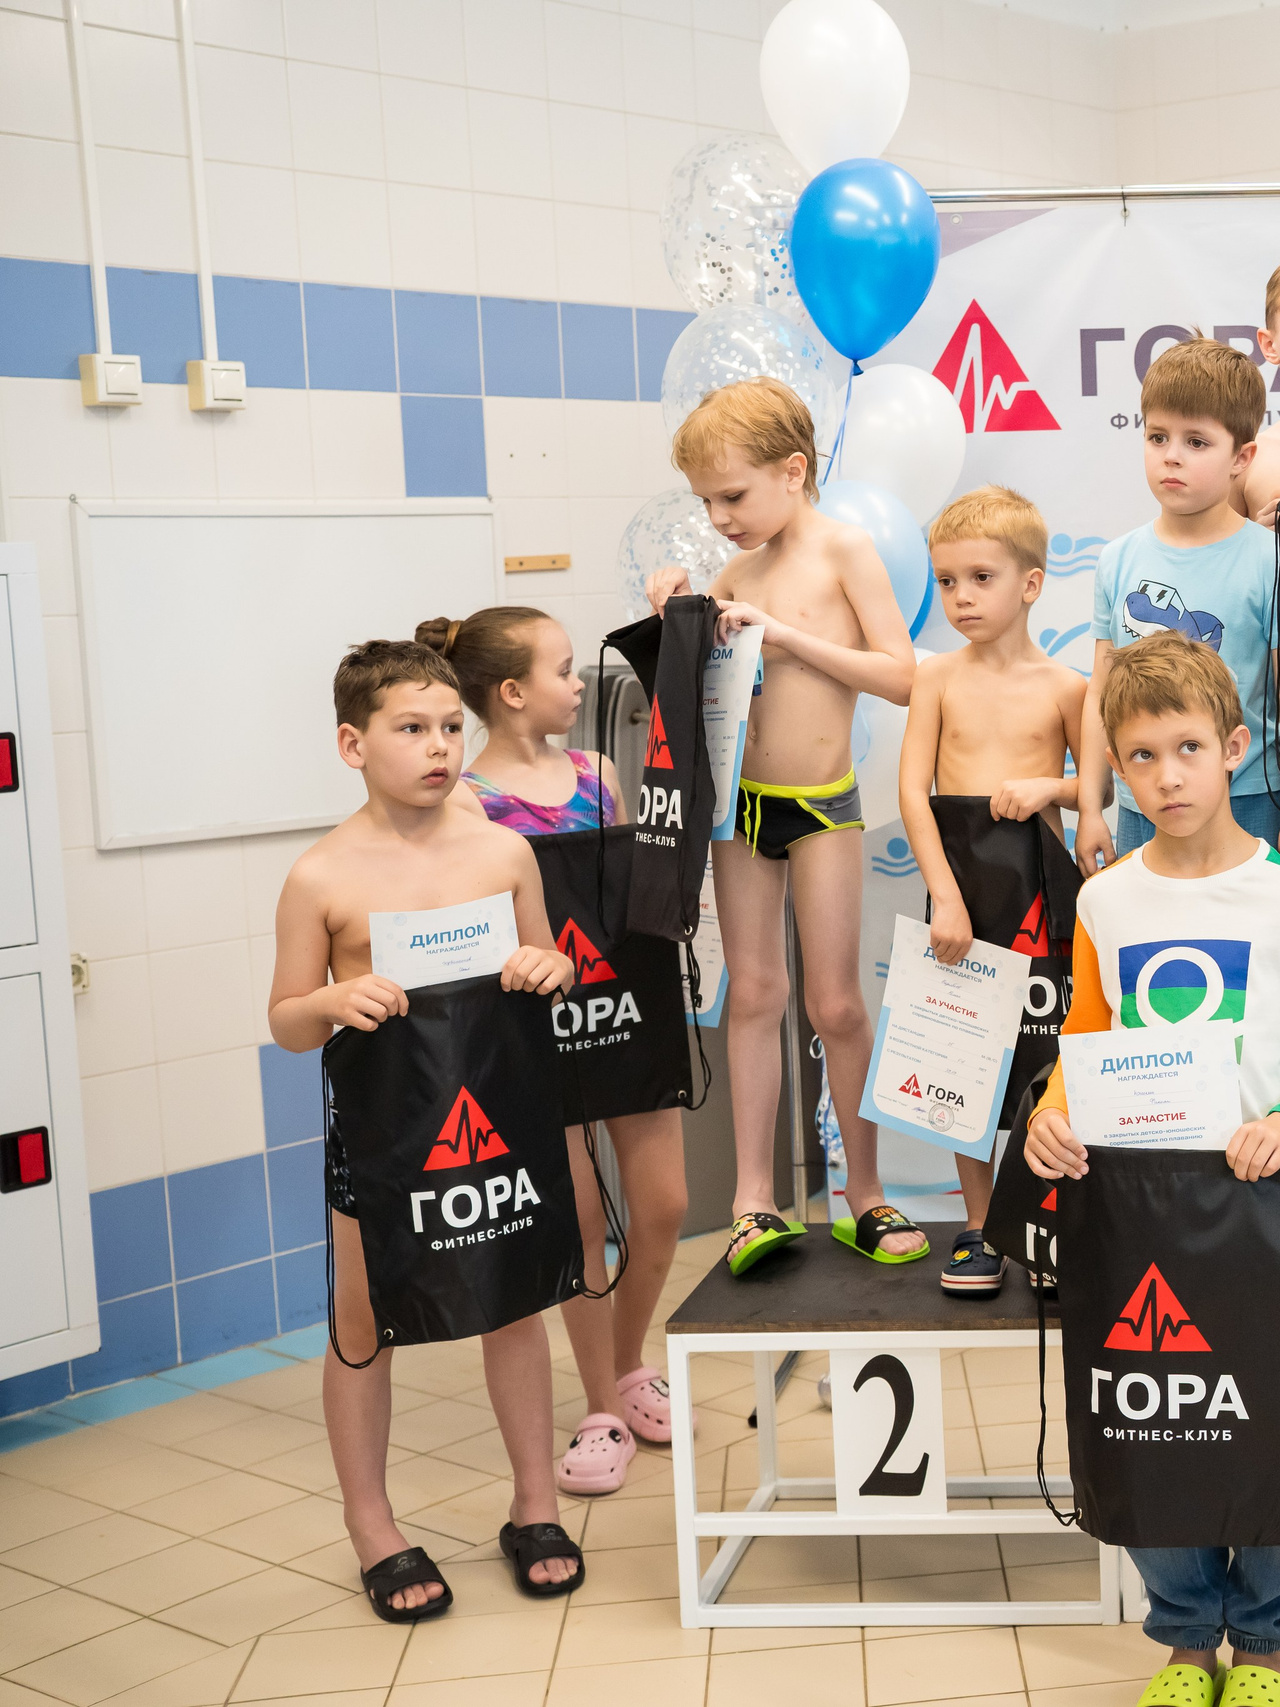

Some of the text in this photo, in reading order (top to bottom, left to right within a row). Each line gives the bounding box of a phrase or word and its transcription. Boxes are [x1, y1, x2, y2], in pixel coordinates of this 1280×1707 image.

[637, 784, 683, 830] ОРА
[635, 831, 676, 847] ТНЕС-КЛУБ
[410, 922, 490, 949] ДИПЛОМ
[426, 942, 480, 955] НАГРАЖДАЕТСЯ
[923, 946, 996, 979] ДЛОМ
[935, 964, 982, 983] НАГРАЖДАЕТСЯ
[551, 991, 642, 1038] ОРА
[925, 995, 979, 1019] ЗА УЧАСТИЕ
[557, 1031, 631, 1053] ТНЕС-КЛУБ
[1100, 1051, 1193, 1075] ДИПЛОМ
[1117, 1071, 1179, 1082] НАГРАЖДАЕТСЯ
[926, 1084, 965, 1107] ГОРА
[1119, 1112, 1187, 1126] ЗА УЧАСТИЕ
[1140, 1126, 1206, 1136] детско-юношеских
[410, 1167, 541, 1233] ГОРА
[430, 1216, 533, 1251] ФИТНЕС-КЛУБ
[1091, 1367, 1250, 1421] ГОРА
[853, 1354, 930, 1497] 2
[1103, 1427, 1232, 1441] ФИТНЕС-КЛУБ
